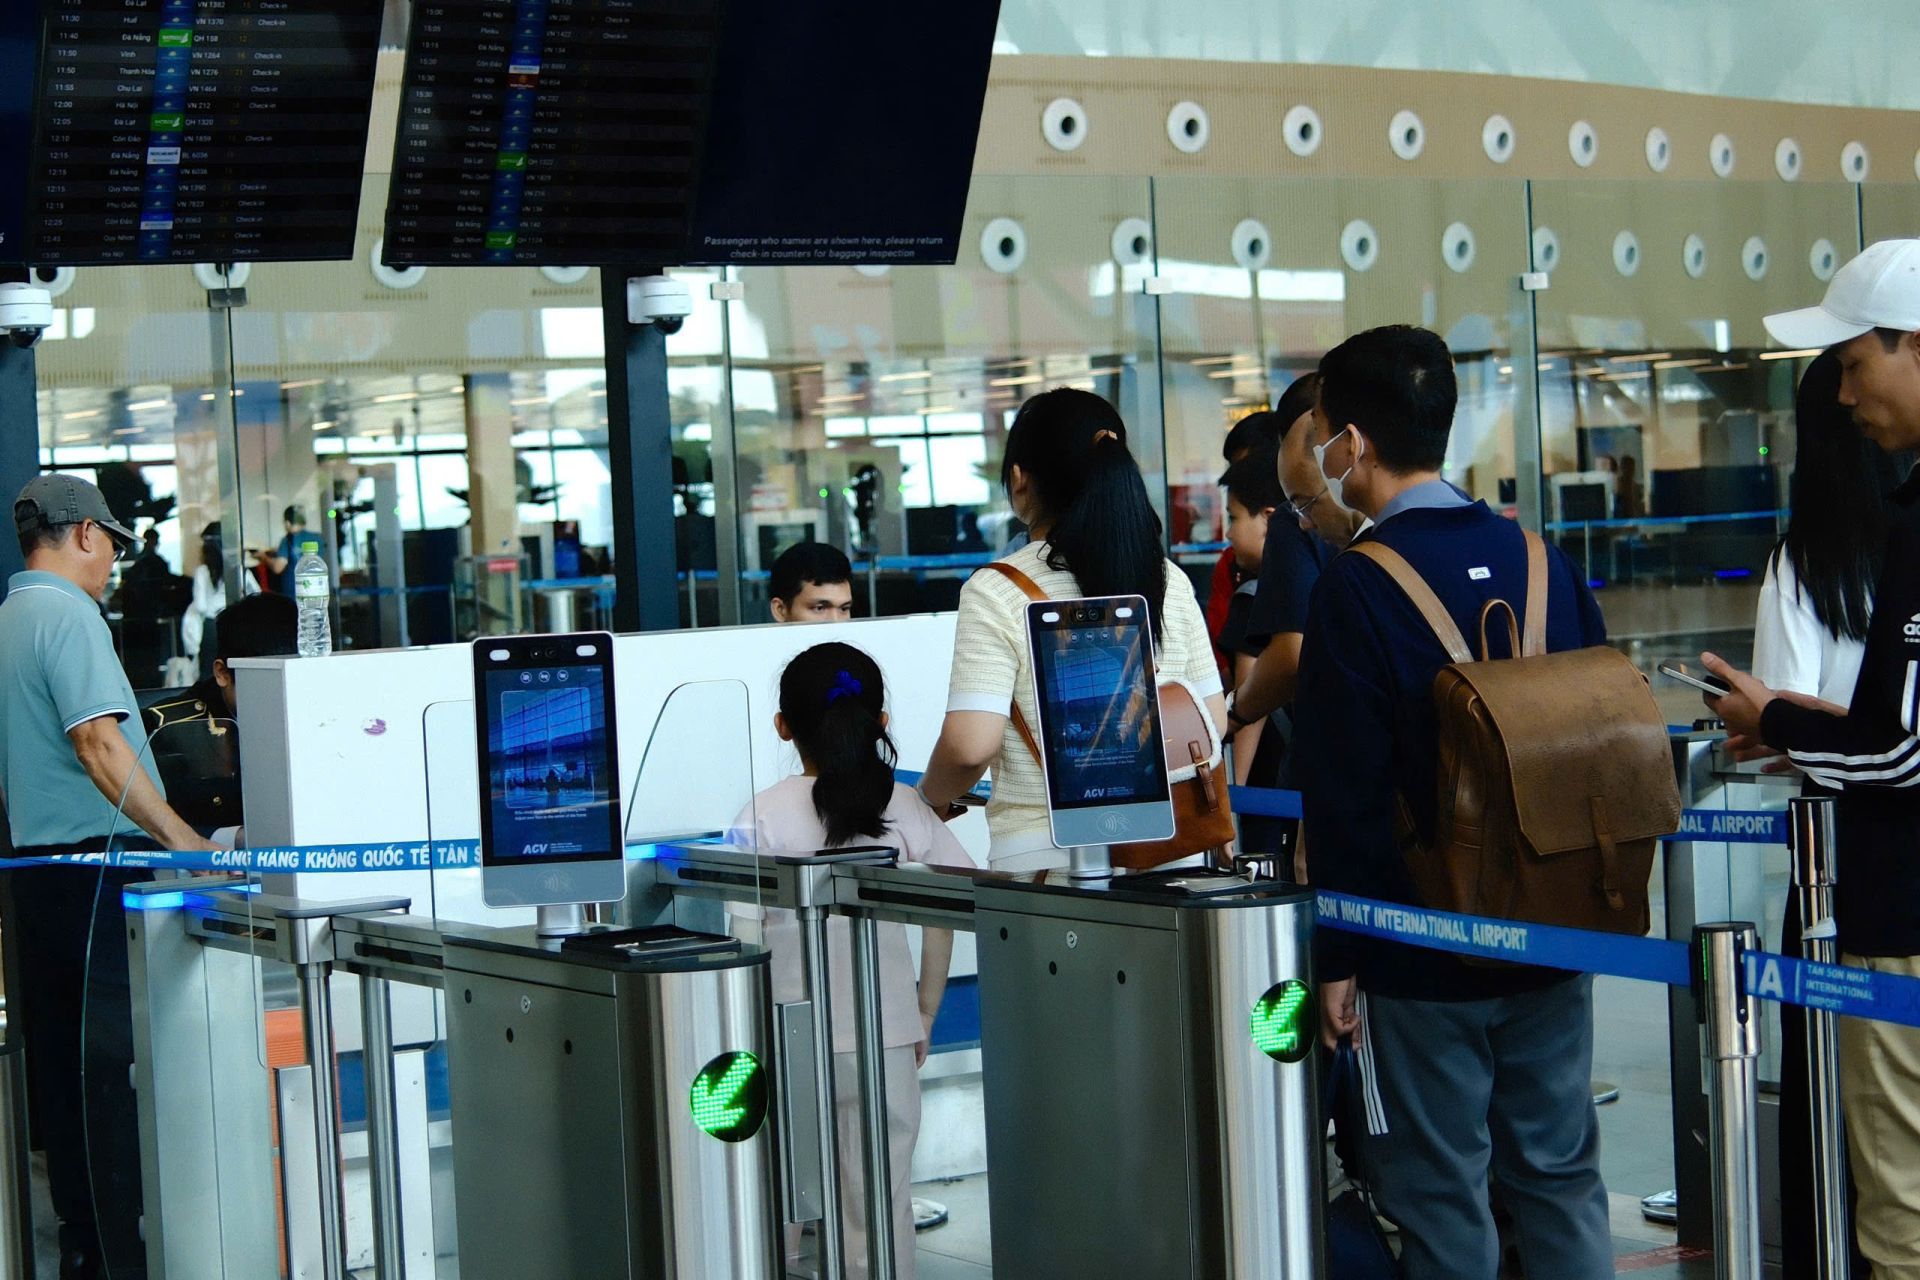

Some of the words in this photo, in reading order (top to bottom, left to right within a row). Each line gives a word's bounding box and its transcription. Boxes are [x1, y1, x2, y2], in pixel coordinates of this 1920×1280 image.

[704, 236, 759, 247] Passengers
[830, 236, 859, 245] shown
[885, 236, 915, 246] please
[814, 249, 827, 257] for
[828, 249, 867, 259] baggage
[869, 249, 915, 259] inspection
[1084, 788, 1105, 798] ACV
[1711, 816, 1774, 834] AIRPORT
[257, 848, 299, 869] HÀNG
[305, 848, 357, 869] KHÔNG
[363, 844, 404, 868] QUỐC
[437, 843, 468, 864] TÂN
[522, 844, 548, 854] ACV
[1317, 895, 1338, 919] SON
[1341, 900, 1371, 926] NHAT
[1374, 907, 1470, 943] INTERNATIONAL
[1472, 922, 1528, 951] AIRPORT
[1740, 953, 1784, 999] IA
[1807, 964, 1824, 976] TAN
[1827, 967, 1844, 979] SON
[1846, 971, 1871, 983] NHAT
[1806, 981, 1873, 1001] INTERNATIONAL
[1806, 994, 1844, 1009] AIRPORT
